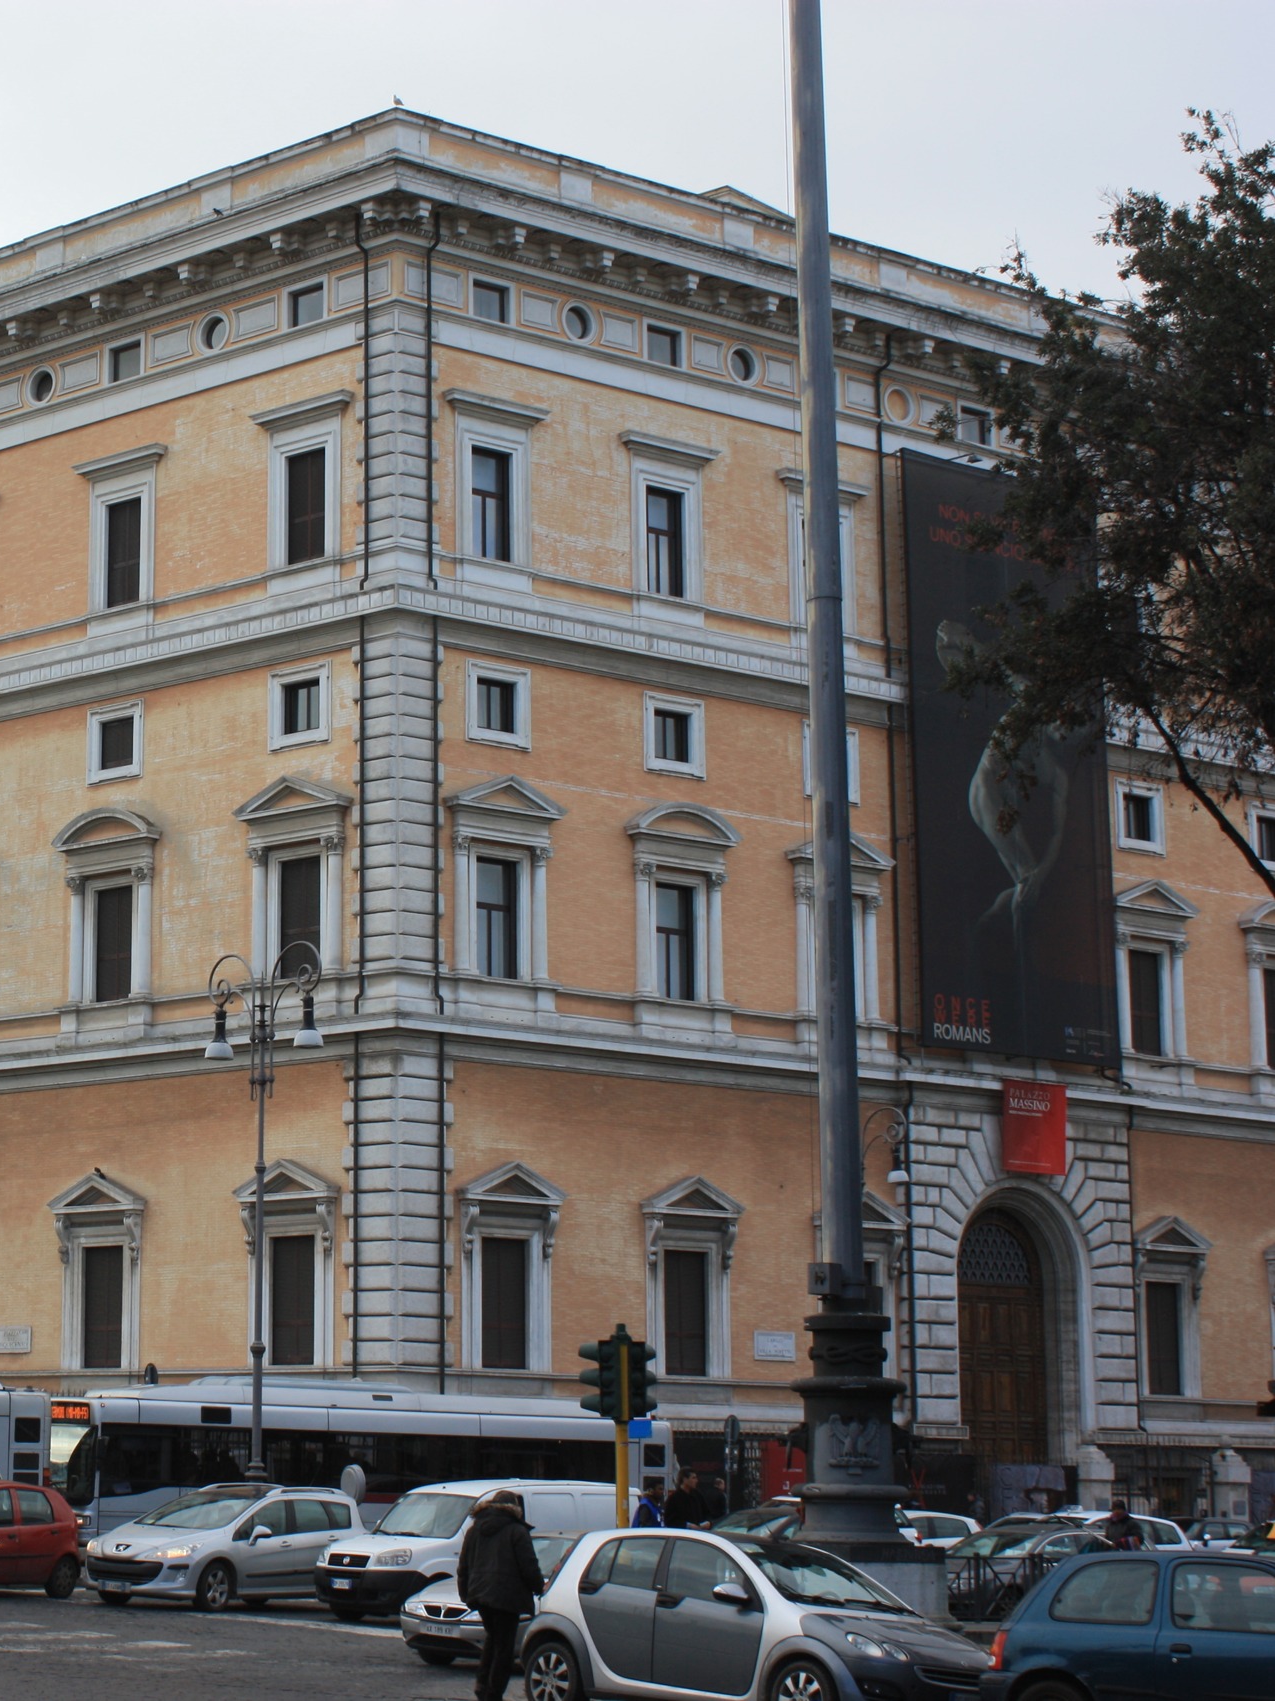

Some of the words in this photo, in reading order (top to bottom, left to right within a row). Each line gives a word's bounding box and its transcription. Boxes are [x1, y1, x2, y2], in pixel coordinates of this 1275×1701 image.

[938, 503, 970, 524] NON
[929, 526, 961, 546] UNO
[933, 1023, 992, 1044] ROMANS
